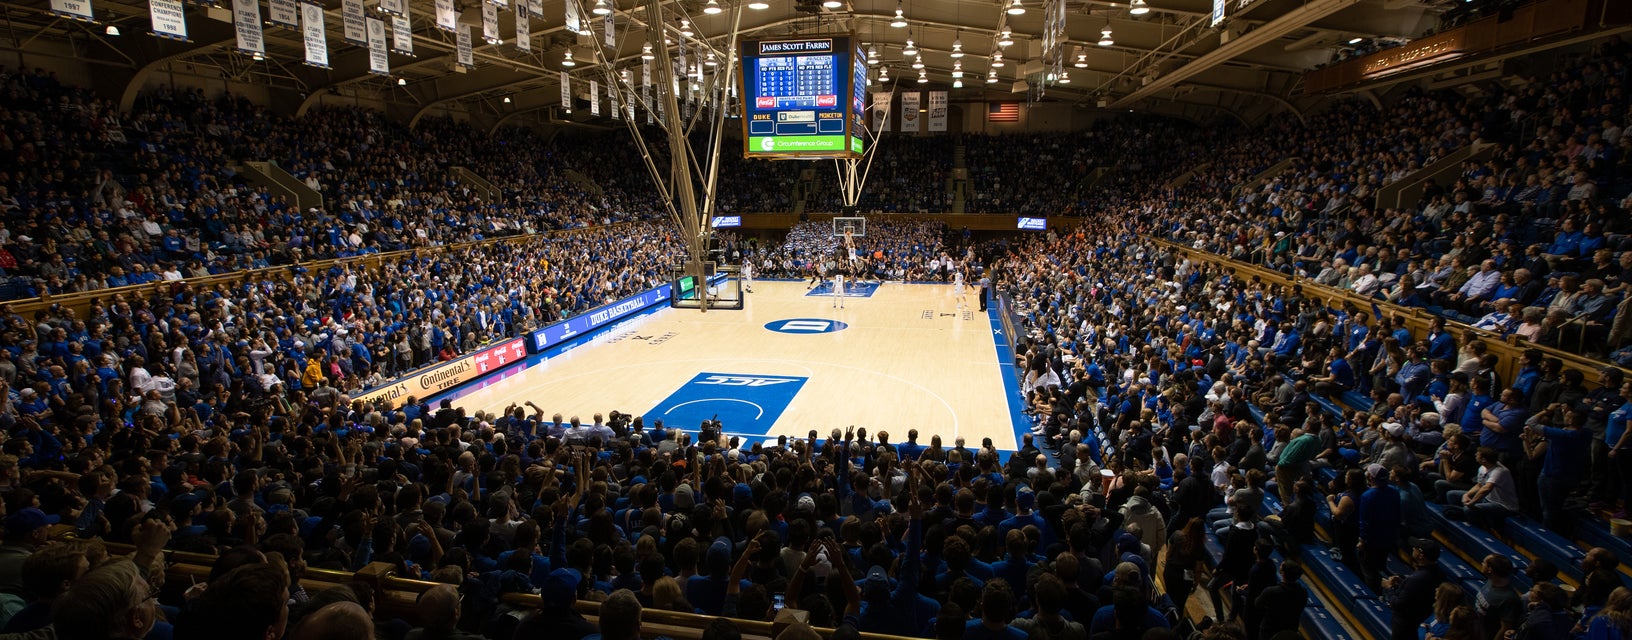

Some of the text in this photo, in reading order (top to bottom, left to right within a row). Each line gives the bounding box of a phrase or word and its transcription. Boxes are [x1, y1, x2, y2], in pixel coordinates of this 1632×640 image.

[151, 1, 182, 12] CONFERENCE
[153, 7, 182, 18] CHAMPIONS
[762, 41, 830, 52] JAMES SCOTT FARRIN
[590, 297, 644, 325] DUKE BASKETBALL
[511, 340, 524, 350] Coca-Cola
[494, 346, 507, 357] Coca-Cola
[476, 353, 489, 364] Coca-Cola
[420, 361, 465, 390] Continental
[694, 375, 801, 387] ACC
[437, 377, 461, 390] TIRE
